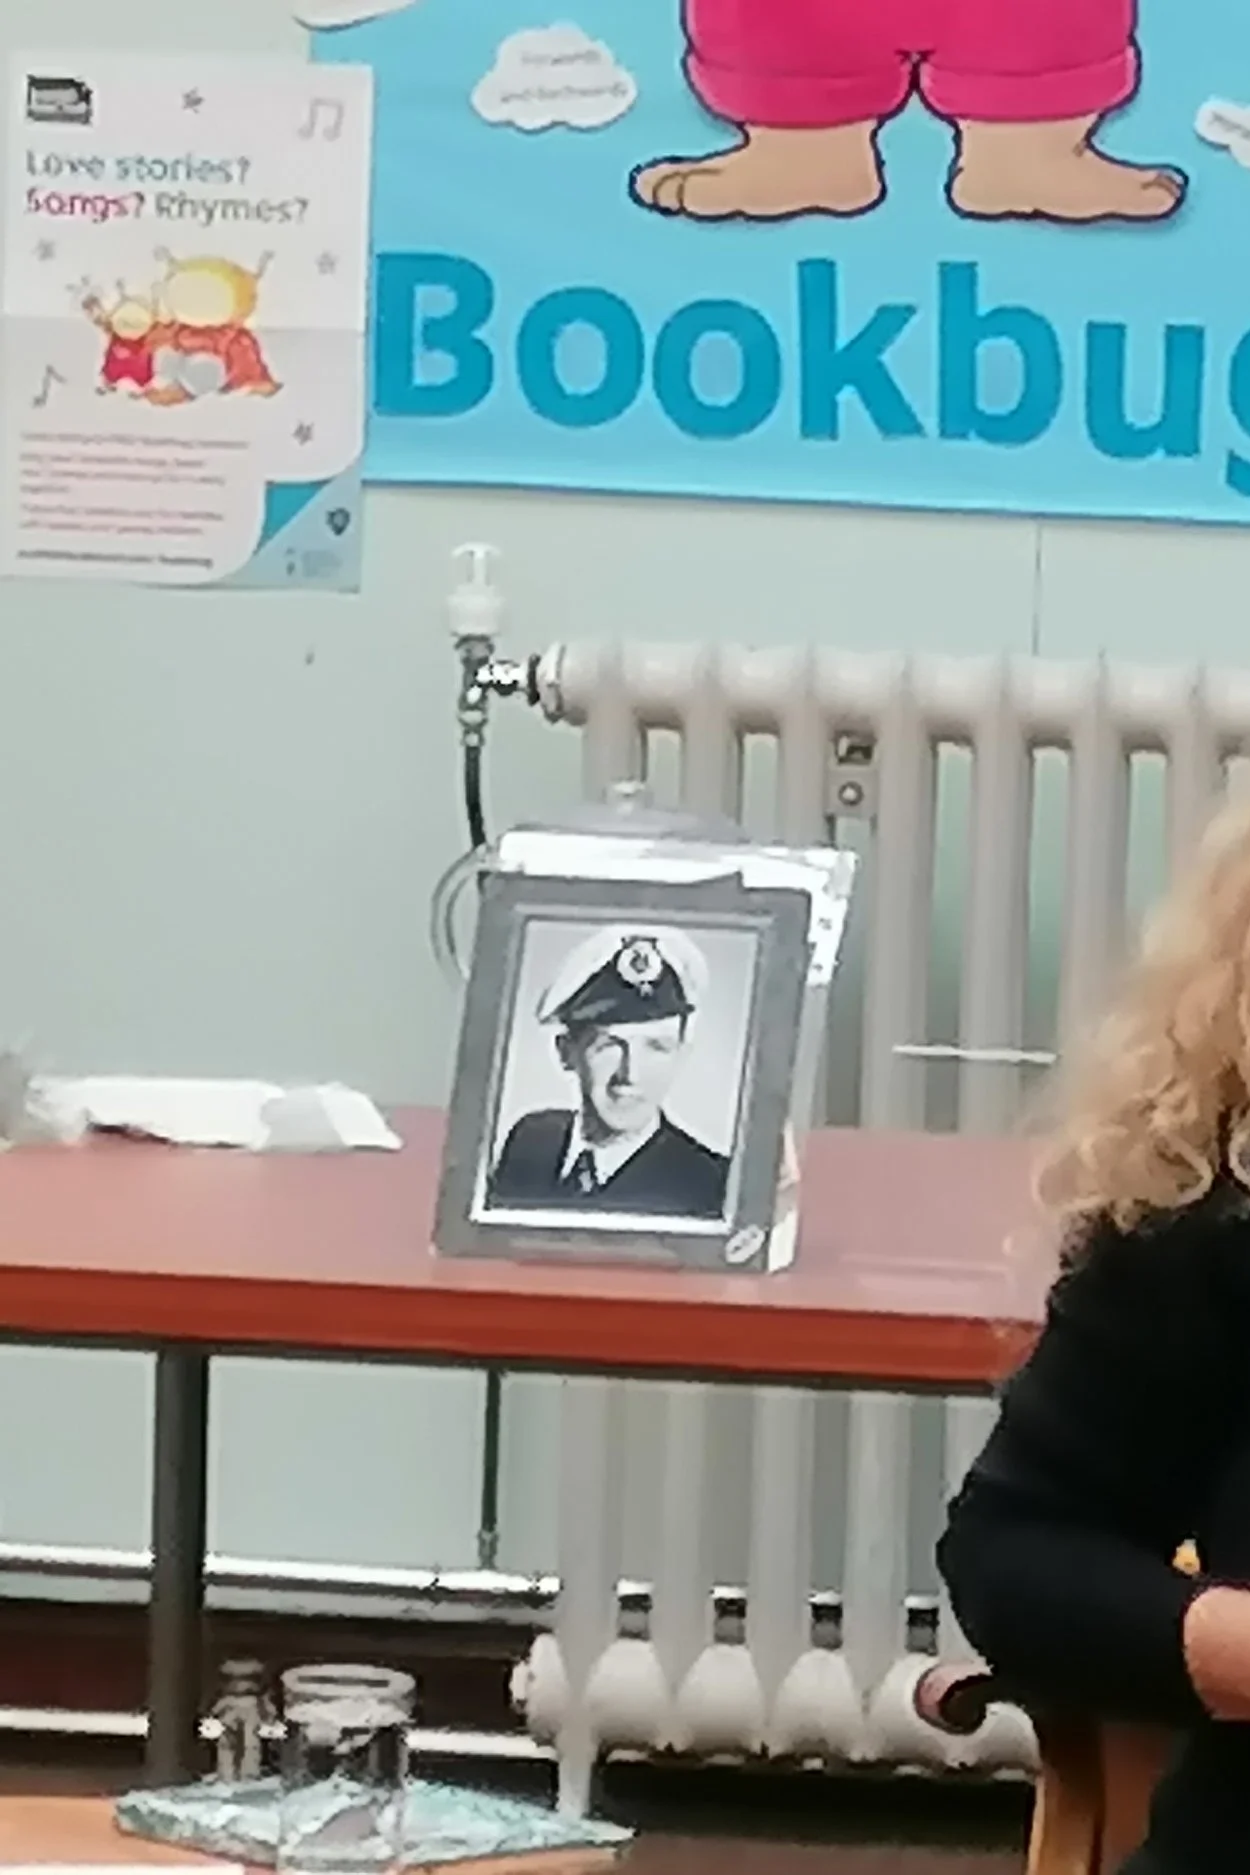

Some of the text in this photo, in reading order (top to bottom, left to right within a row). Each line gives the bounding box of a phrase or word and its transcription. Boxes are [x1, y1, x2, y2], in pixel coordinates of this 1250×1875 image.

[26, 151, 250, 183] Love stories?
[25, 187, 308, 226] Songs? Rhymes?
